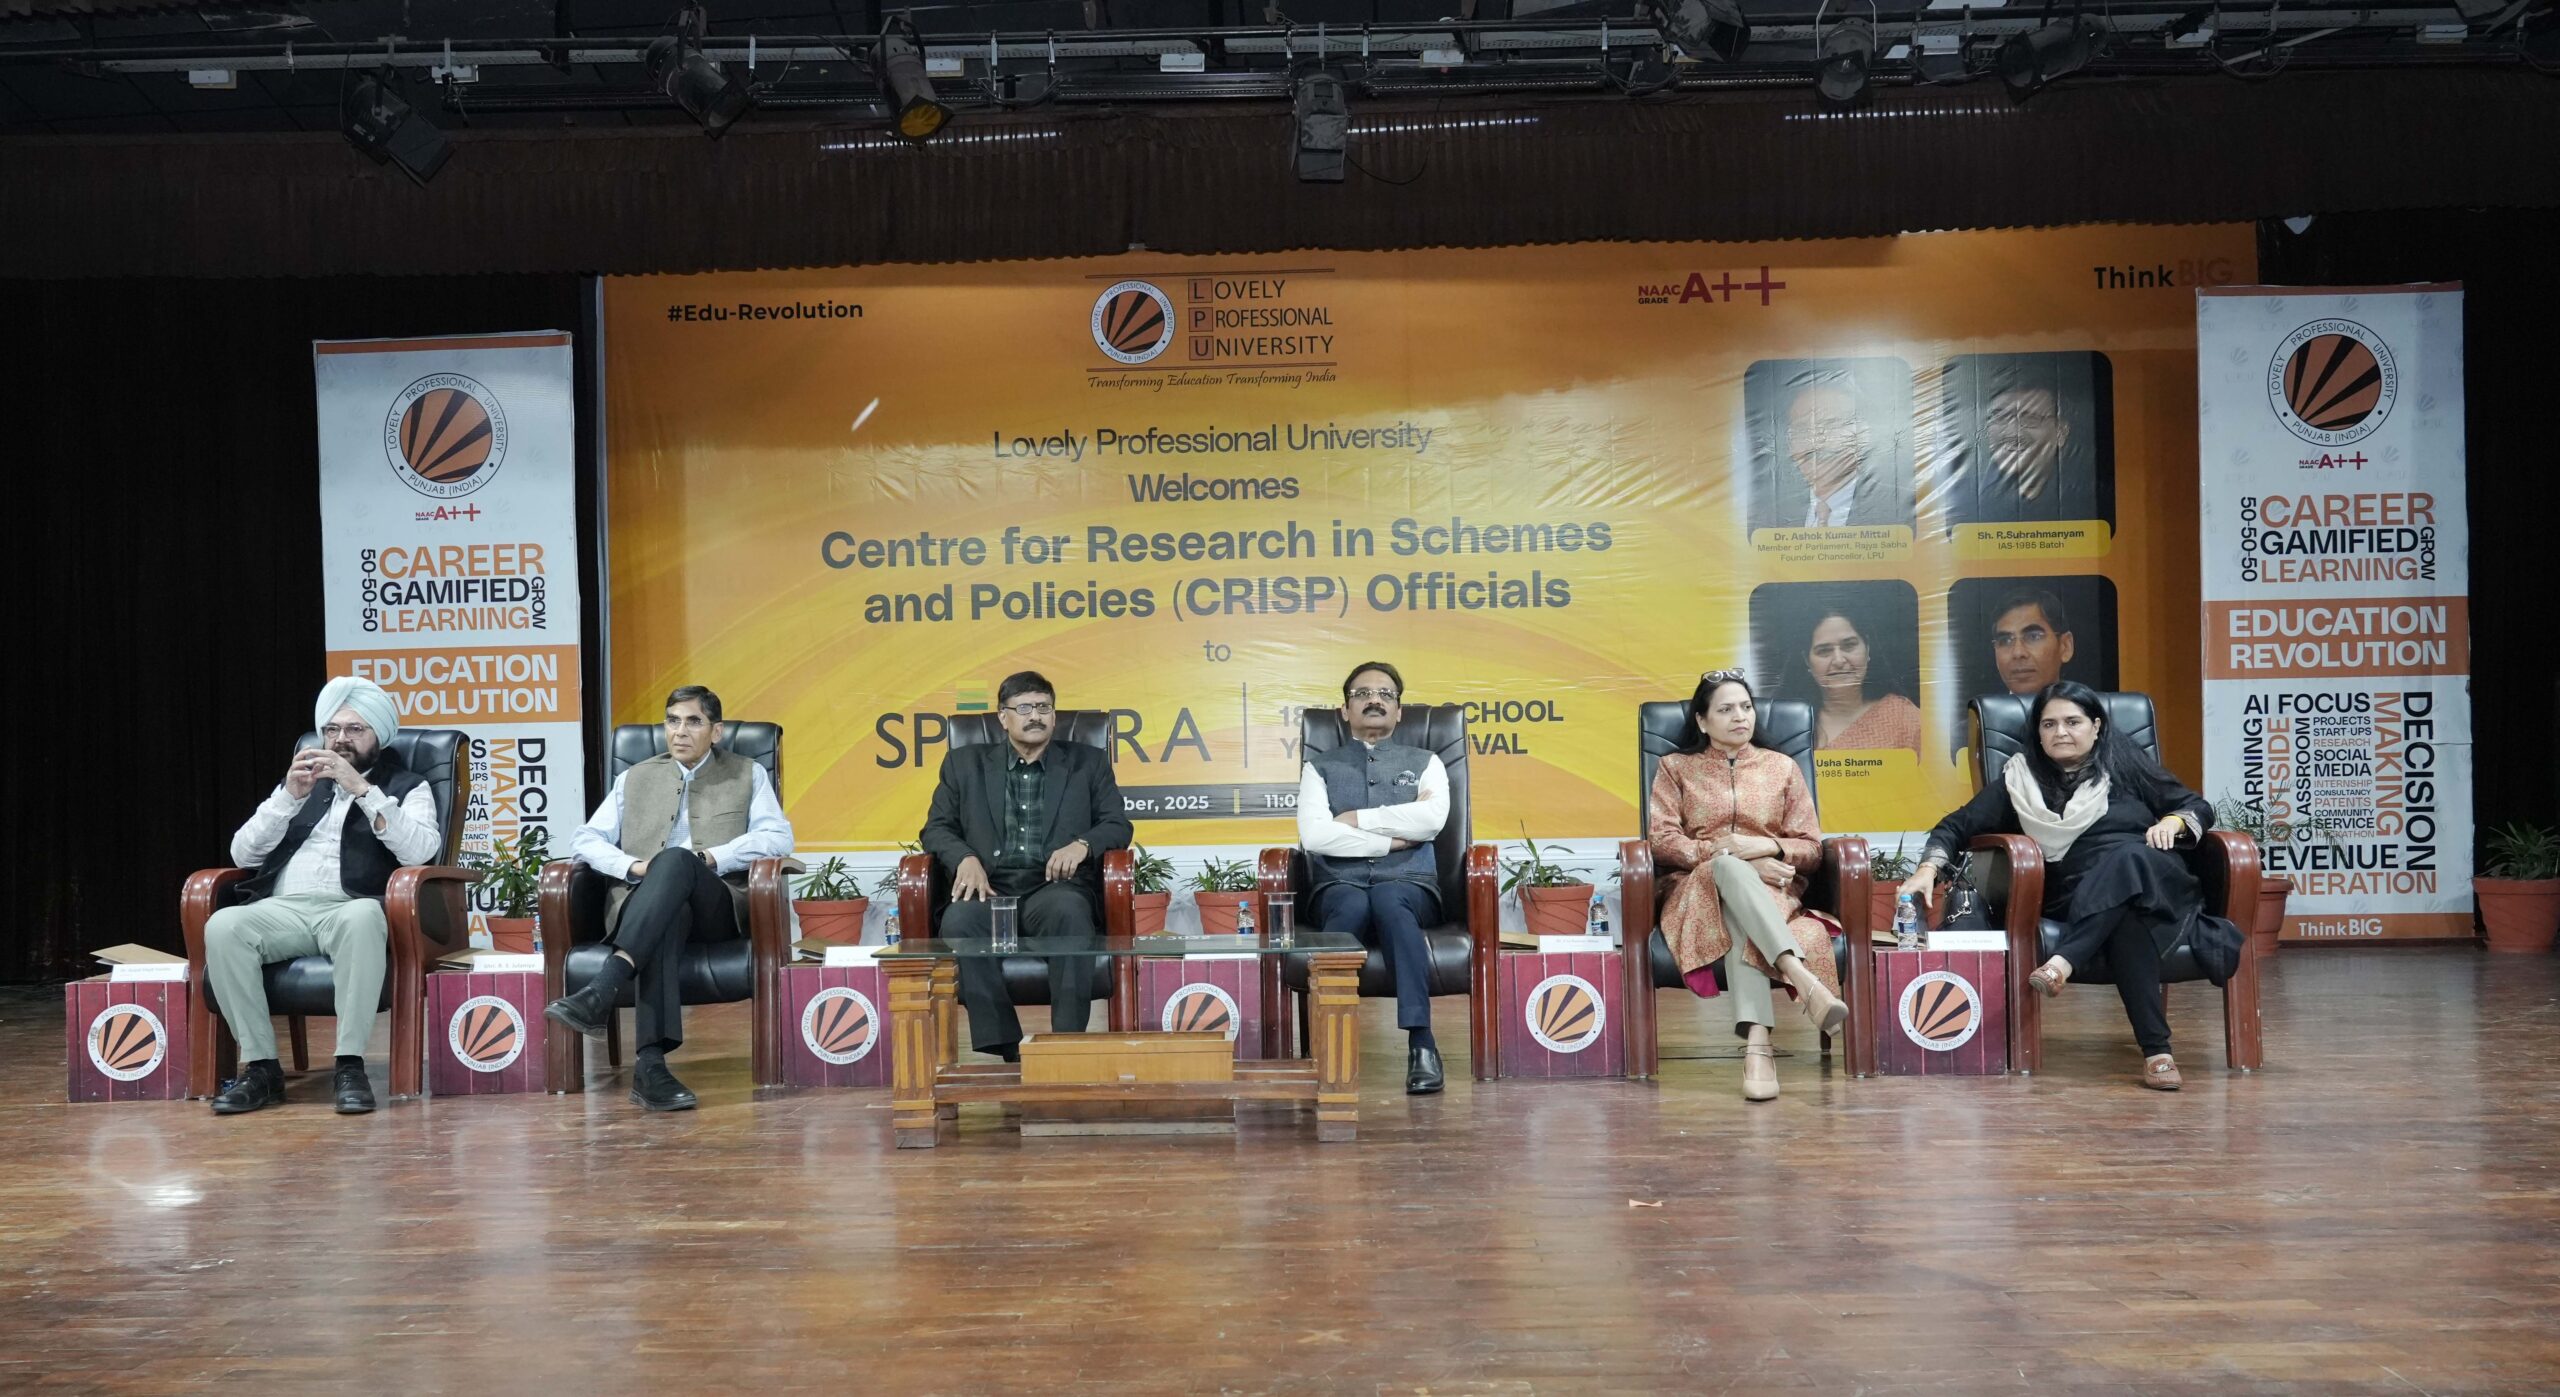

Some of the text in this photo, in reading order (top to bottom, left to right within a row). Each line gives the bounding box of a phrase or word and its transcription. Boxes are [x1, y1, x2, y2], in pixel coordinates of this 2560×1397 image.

[1193, 279, 1286, 300] LOVELY
[1638, 266, 1786, 306] NAAC A++
[667, 300, 863, 322] #Edu-Revolution
[1093, 283, 1174, 333] LOVELY PROFESSIONAL UNIVERSITY
[1638, 297, 1668, 305] GRADE
[1194, 307, 1333, 329] PROFESSIONAL
[1107, 347, 1132, 361] PUNJAB
[1195, 335, 1334, 357] UNIVERSITY
[2271, 322, 2395, 400] LOVELY PROFESSIONAL UNIVERSITY
[1087, 368, 1336, 393] Transforming Education Transforming India
[388, 376, 505, 453] LOVELY PROFESSIONAL UNIVERSITY
[994, 421, 1433, 463] Lovely Professional University
[2292, 420, 2371, 444] PUNJAB (INDIA)
[408, 474, 483, 496] PUNJAB (INDIA)
[1128, 472, 1299, 503] Welcomes
[2259, 492, 2436, 528] CAREER
[821, 516, 1612, 569] Centre for Research in Schemes
[1757, 544, 1791, 552] Member
[1794, 543, 1802, 551] of
[1855, 542, 1878, 551] Rajya
[1880, 541, 1907, 549] Sabha
[1774, 530, 1890, 541] Dr. Ashok Kumar Mittal
[1978, 531, 1994, 540] Sh.
[1998, 541, 2064, 550] IAS-1985 Batch
[2240, 496, 2258, 582] 50-50-50
[2260, 528, 2418, 556] GAMIFIED
[379, 543, 545, 579] CAREER
[1781, 551, 1884, 562] Founder Chancellor, LPU
[2420, 526, 2436, 581] GROW
[2261, 557, 2418, 583] LEARNING
[361, 549, 378, 632] 50-50-50
[379, 578, 530, 606] GAMIFIED
[864, 570, 1572, 624] and Policies (CRISP) Officials
[531, 576, 546, 630] GROW
[381, 606, 529, 633] LEARNING
[2229, 606, 2446, 637] EDUCATION
[1203, 640, 1231, 662] to
[2230, 640, 2446, 669] REVOLUTION
[351, 654, 557, 686] EDUCATION
[386, 688, 557, 716] VOLUTION
[2243, 692, 2371, 715] AI FOCUS
[2313, 716, 2371, 726] PROJECTS
[2313, 727, 2372, 737] START-UPS
[2313, 738, 2371, 748] RESEARCH
[1816, 758, 1883, 767] Usha Sharma
[2313, 749, 2372, 762] SOCIAL
[2374, 692, 2404, 837] MAKING
[2267, 717, 2292, 842] OUTSIDE
[2295, 717, 2313, 842] CLASSROOM
[2314, 762, 2372, 777] MEDIA
[2403, 691, 2436, 871] DECISION
[2314, 779, 2373, 788] INTERNSHIP
[2314, 789, 2371, 797] CONSULTANCY
[1123, 795, 1209, 813] ber, 2025
[2314, 809, 2374, 817] COMMUNITY
[2315, 797, 2372, 808] PATENTS
[2314, 817, 2375, 829] SERVICE
[2315, 830, 2375, 838] HACKATHON
[2269, 871, 2437, 896] NERATION
[1175, 985, 1221, 1000] PROFESSIONAL
[1901, 994, 1909, 1020] LOVELY
[1912, 973, 1960, 988] PROFESSIONAL
[101, 1005, 147, 1020] PROFESSIONAL
[450, 998, 523, 1044] LOVELY PROFESSIONAL UNIVERSITY
[803, 989, 877, 1036] LOVELY PROFESSIONAL UNIVERSITY
[463, 1056, 487, 1070] PUNJAB
[817, 1049, 841, 1062] PUNJAB
